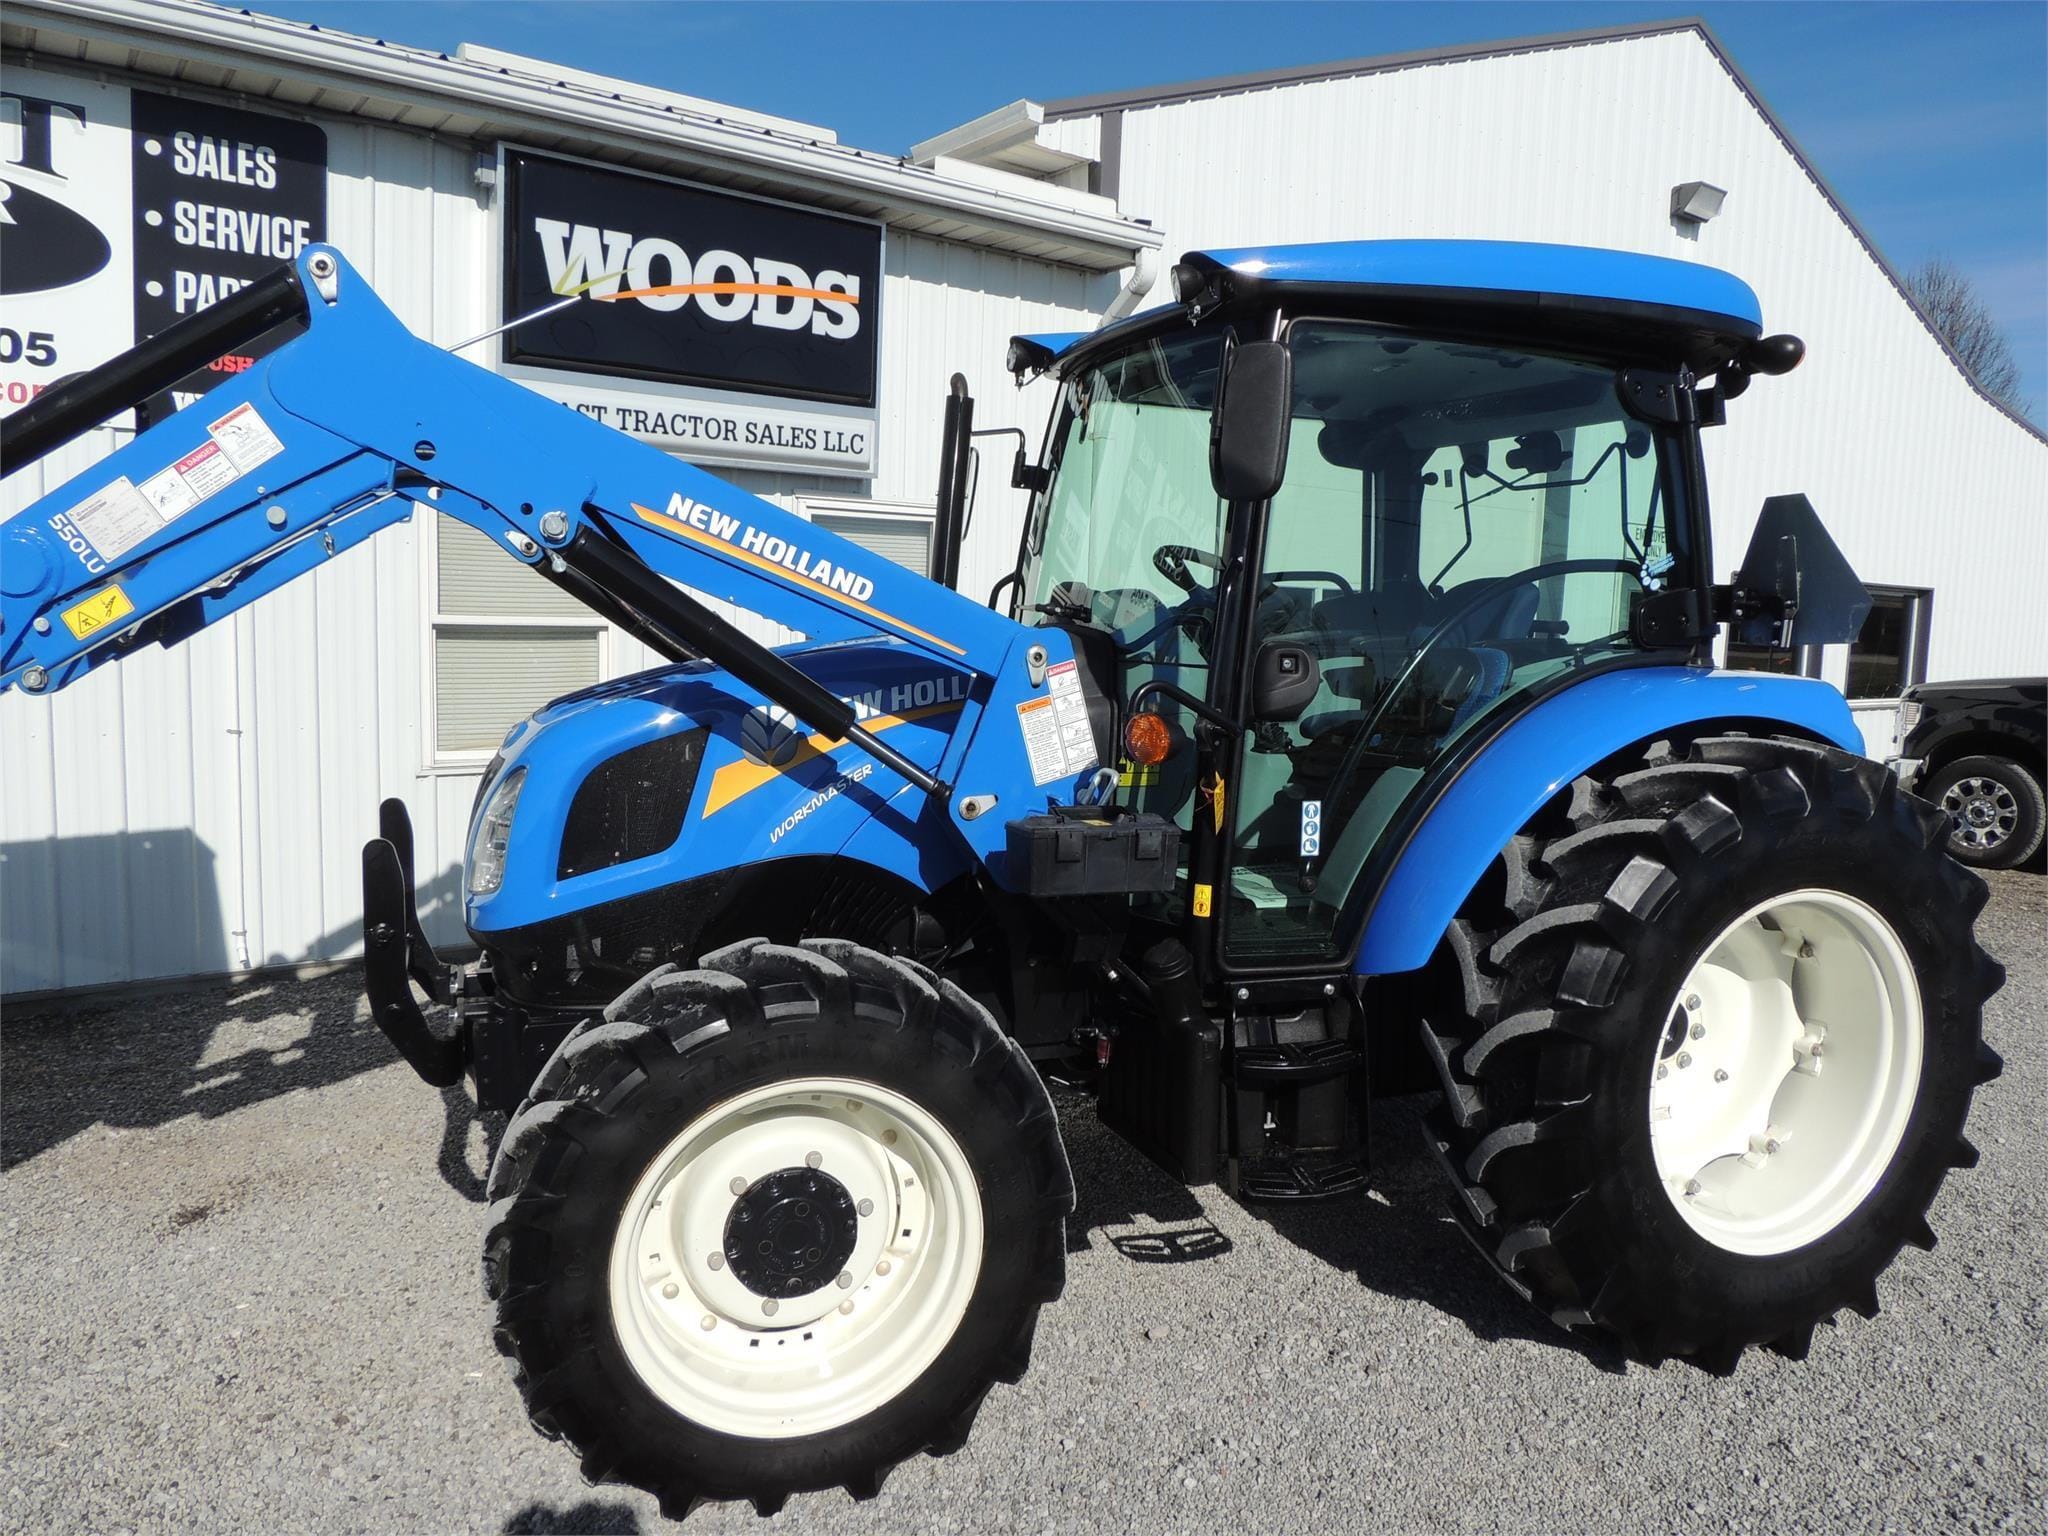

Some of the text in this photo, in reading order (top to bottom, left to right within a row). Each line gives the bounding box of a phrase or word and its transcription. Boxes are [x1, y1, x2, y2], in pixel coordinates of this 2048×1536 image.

[173, 131, 277, 189] SALES
[174, 201, 310, 259] SERVICE
[535, 217, 860, 340] WOODS
[616, 408, 738, 442] TRACTOR
[745, 422, 817, 450] SALES
[823, 430, 864, 454] LLC
[666, 492, 874, 602] NEW HOLLAND
[891, 676, 965, 712] HOLL
[770, 763, 873, 844] WORKMASTER
